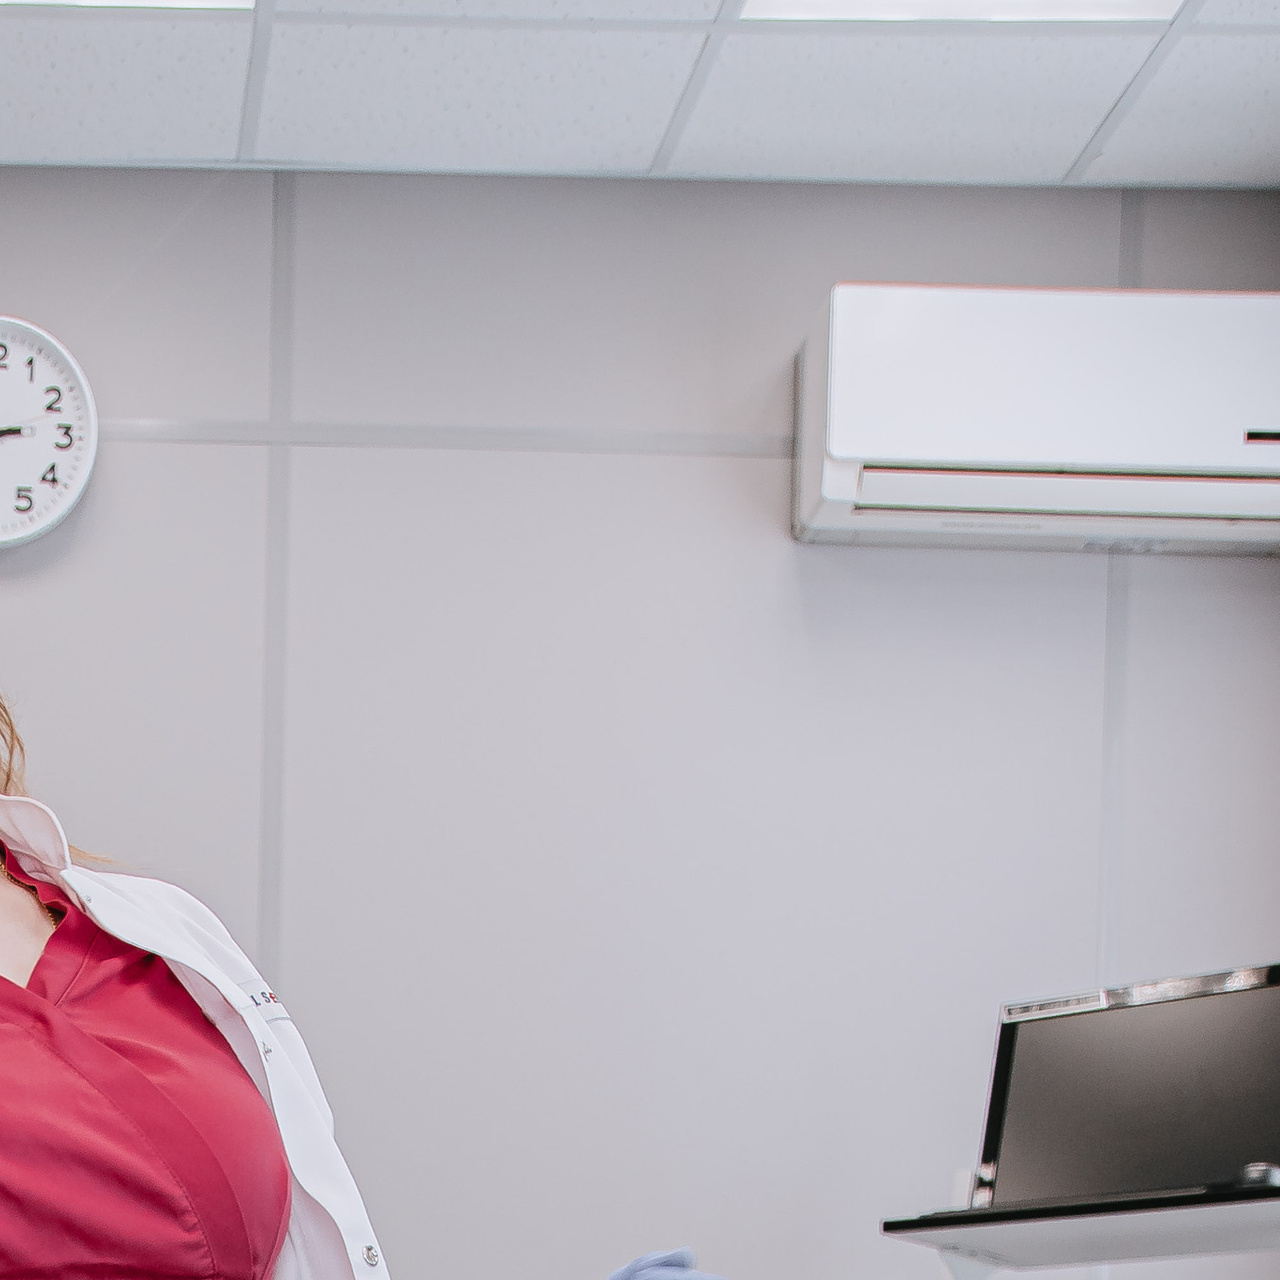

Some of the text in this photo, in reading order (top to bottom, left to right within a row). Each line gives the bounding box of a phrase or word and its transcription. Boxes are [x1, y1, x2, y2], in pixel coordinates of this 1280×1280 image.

[25, 356, 34, 382] 1
[44, 385, 62, 412] 2
[54, 423, 74, 450] 3
[41, 462, 58, 487] 4
[14, 486, 33, 512] 5
